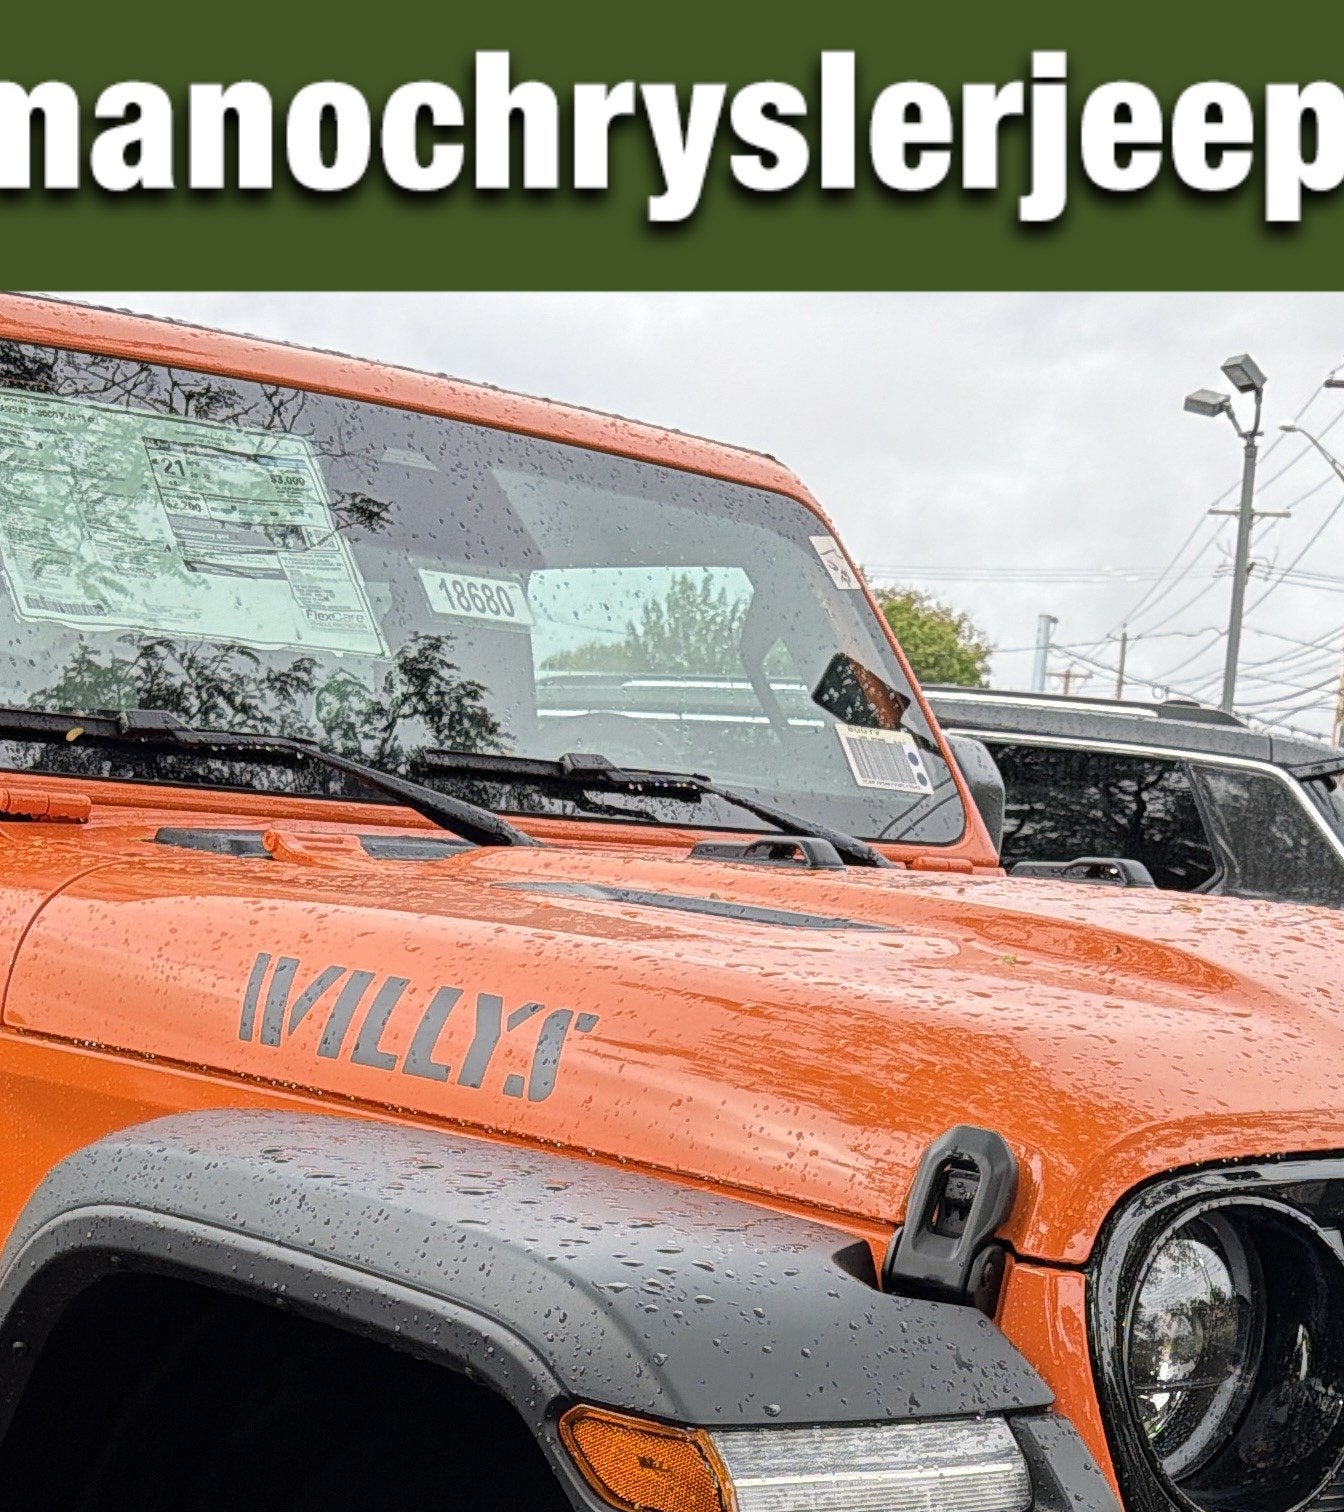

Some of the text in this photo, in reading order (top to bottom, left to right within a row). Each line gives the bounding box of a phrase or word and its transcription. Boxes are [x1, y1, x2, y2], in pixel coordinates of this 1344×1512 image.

[161, 457, 185, 477] 21
[439, 577, 515, 617] 18680
[238, 952, 600, 1102] WILLYS
